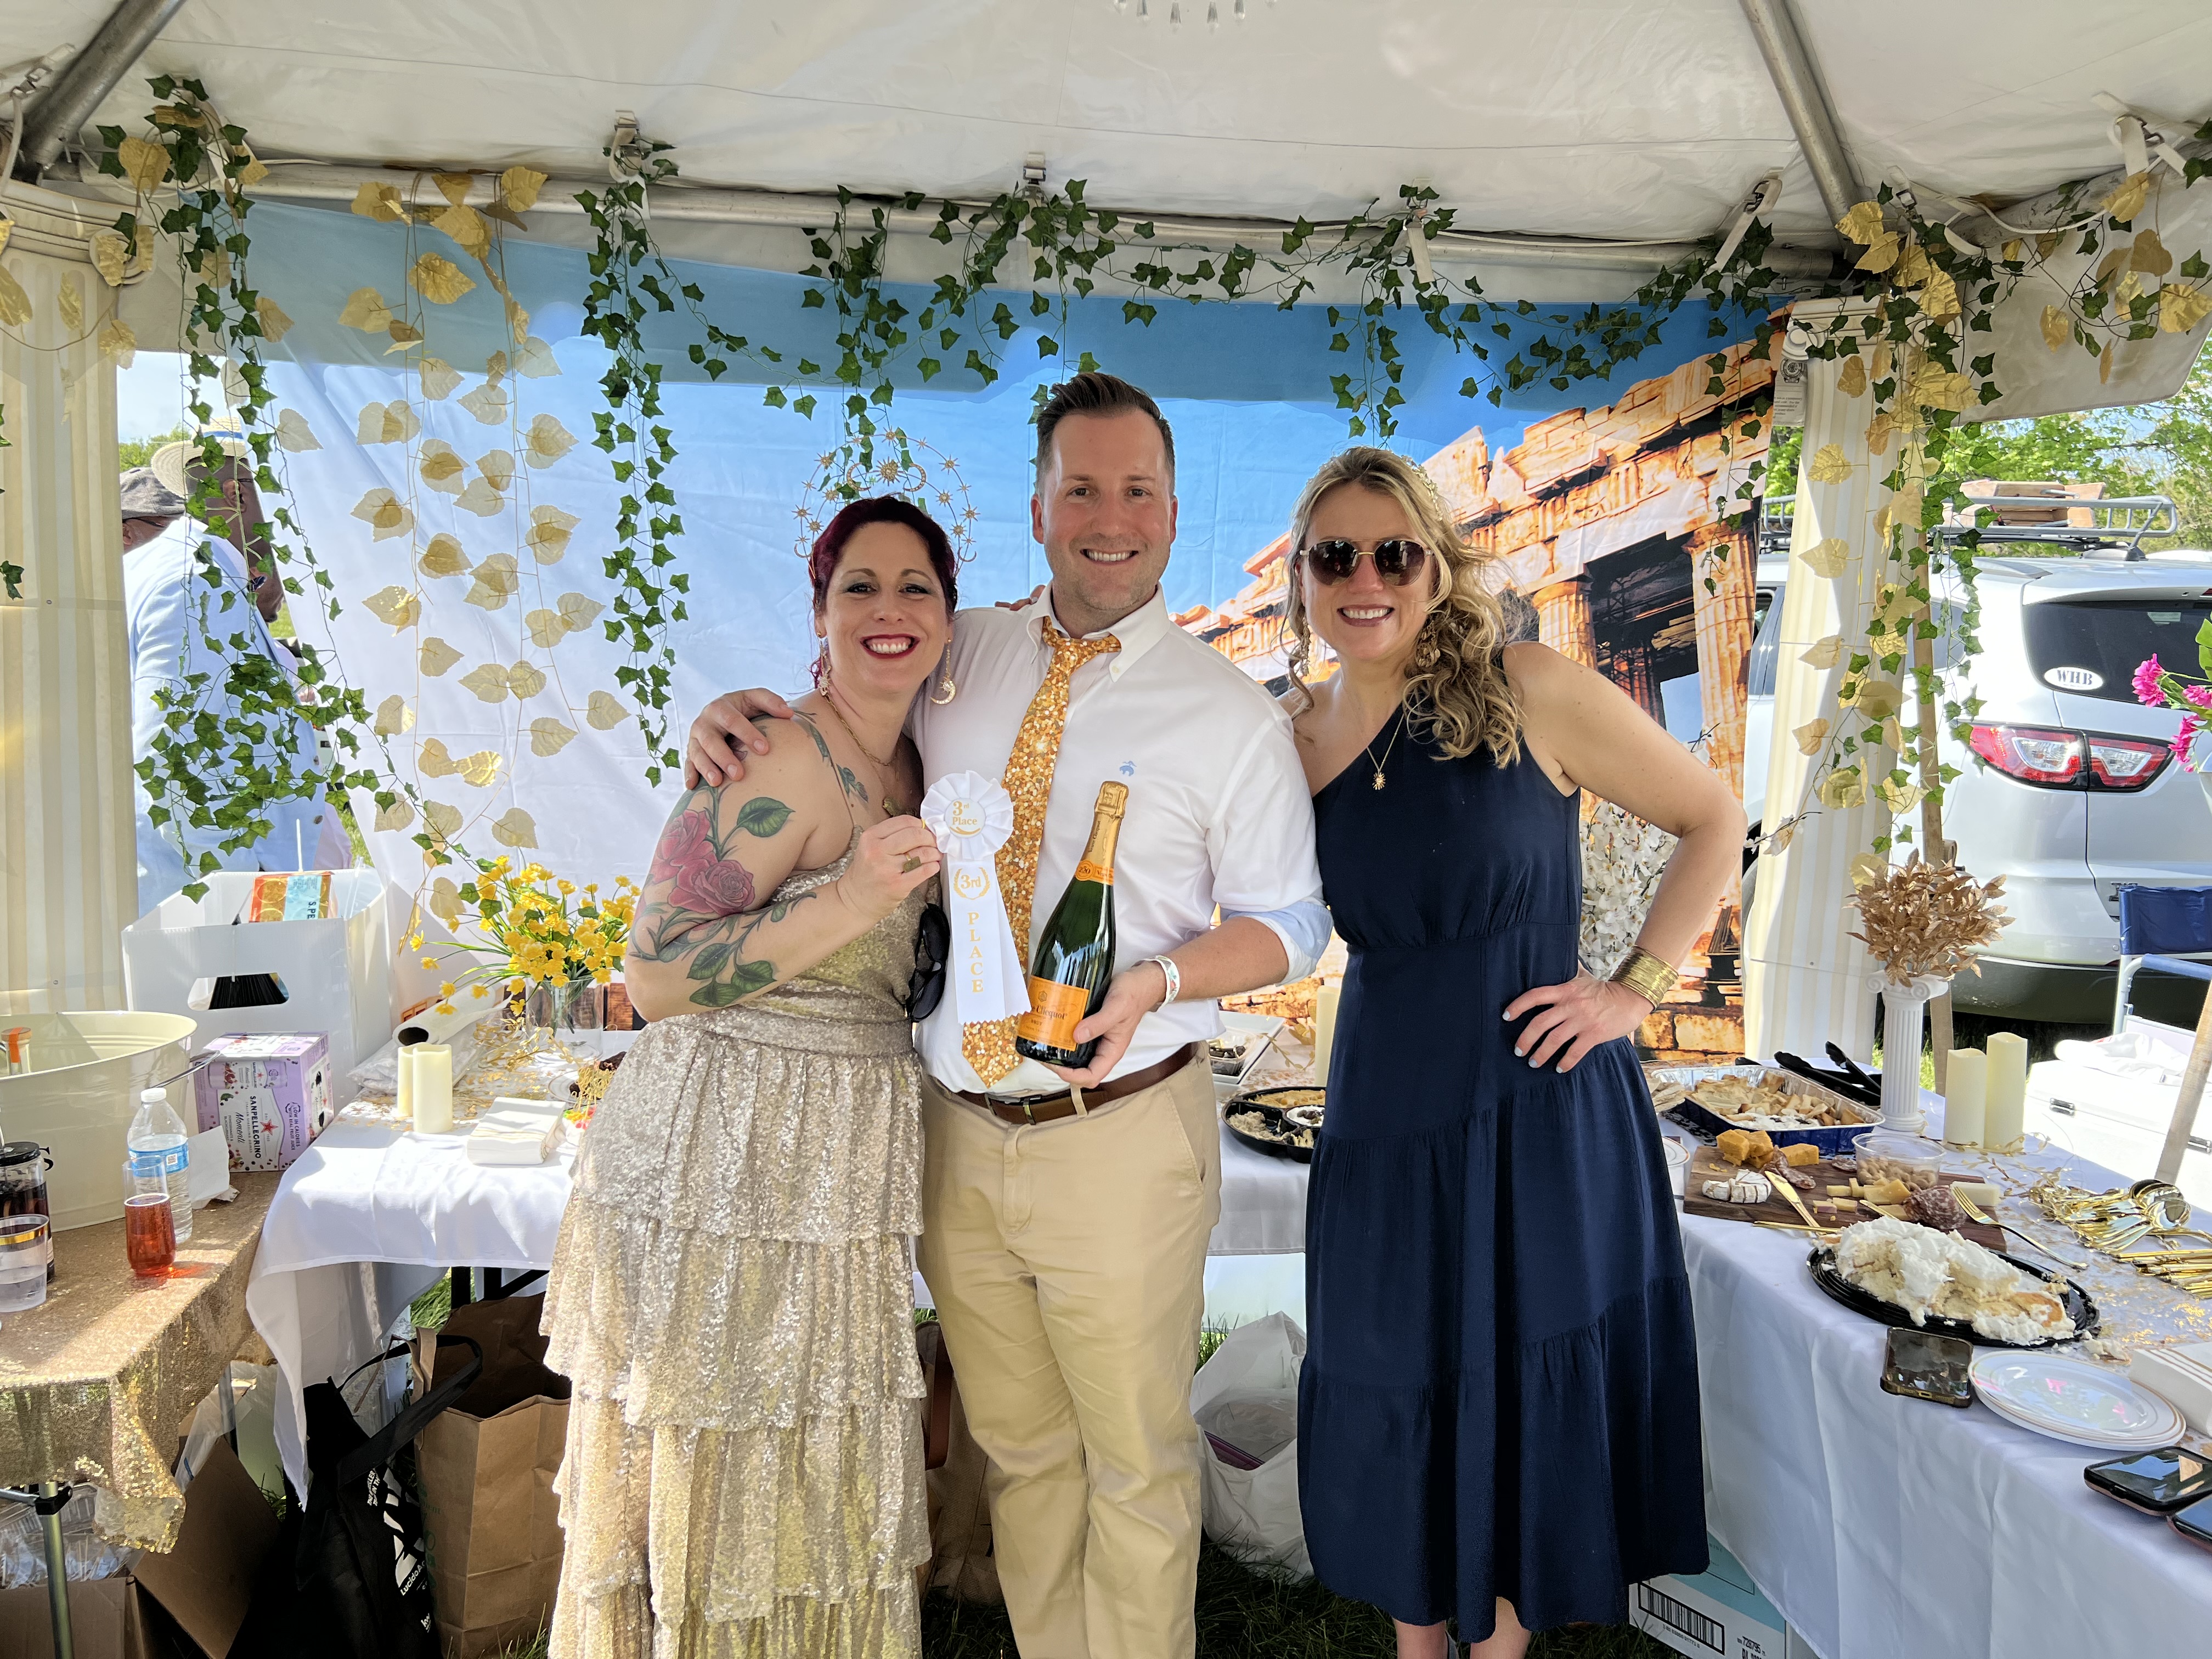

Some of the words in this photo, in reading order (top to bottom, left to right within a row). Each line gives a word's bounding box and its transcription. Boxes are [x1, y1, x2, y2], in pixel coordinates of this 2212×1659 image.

[2056, 669, 2092, 685] WHB
[952, 801, 970, 816] 3rd
[952, 816, 978, 825] Place
[961, 874, 981, 889] 3rd
[967, 912, 984, 993] PLACE
[235, 1111, 246, 1144] Momenti
[250, 1096, 262, 1159] SANPELLEGRINO
